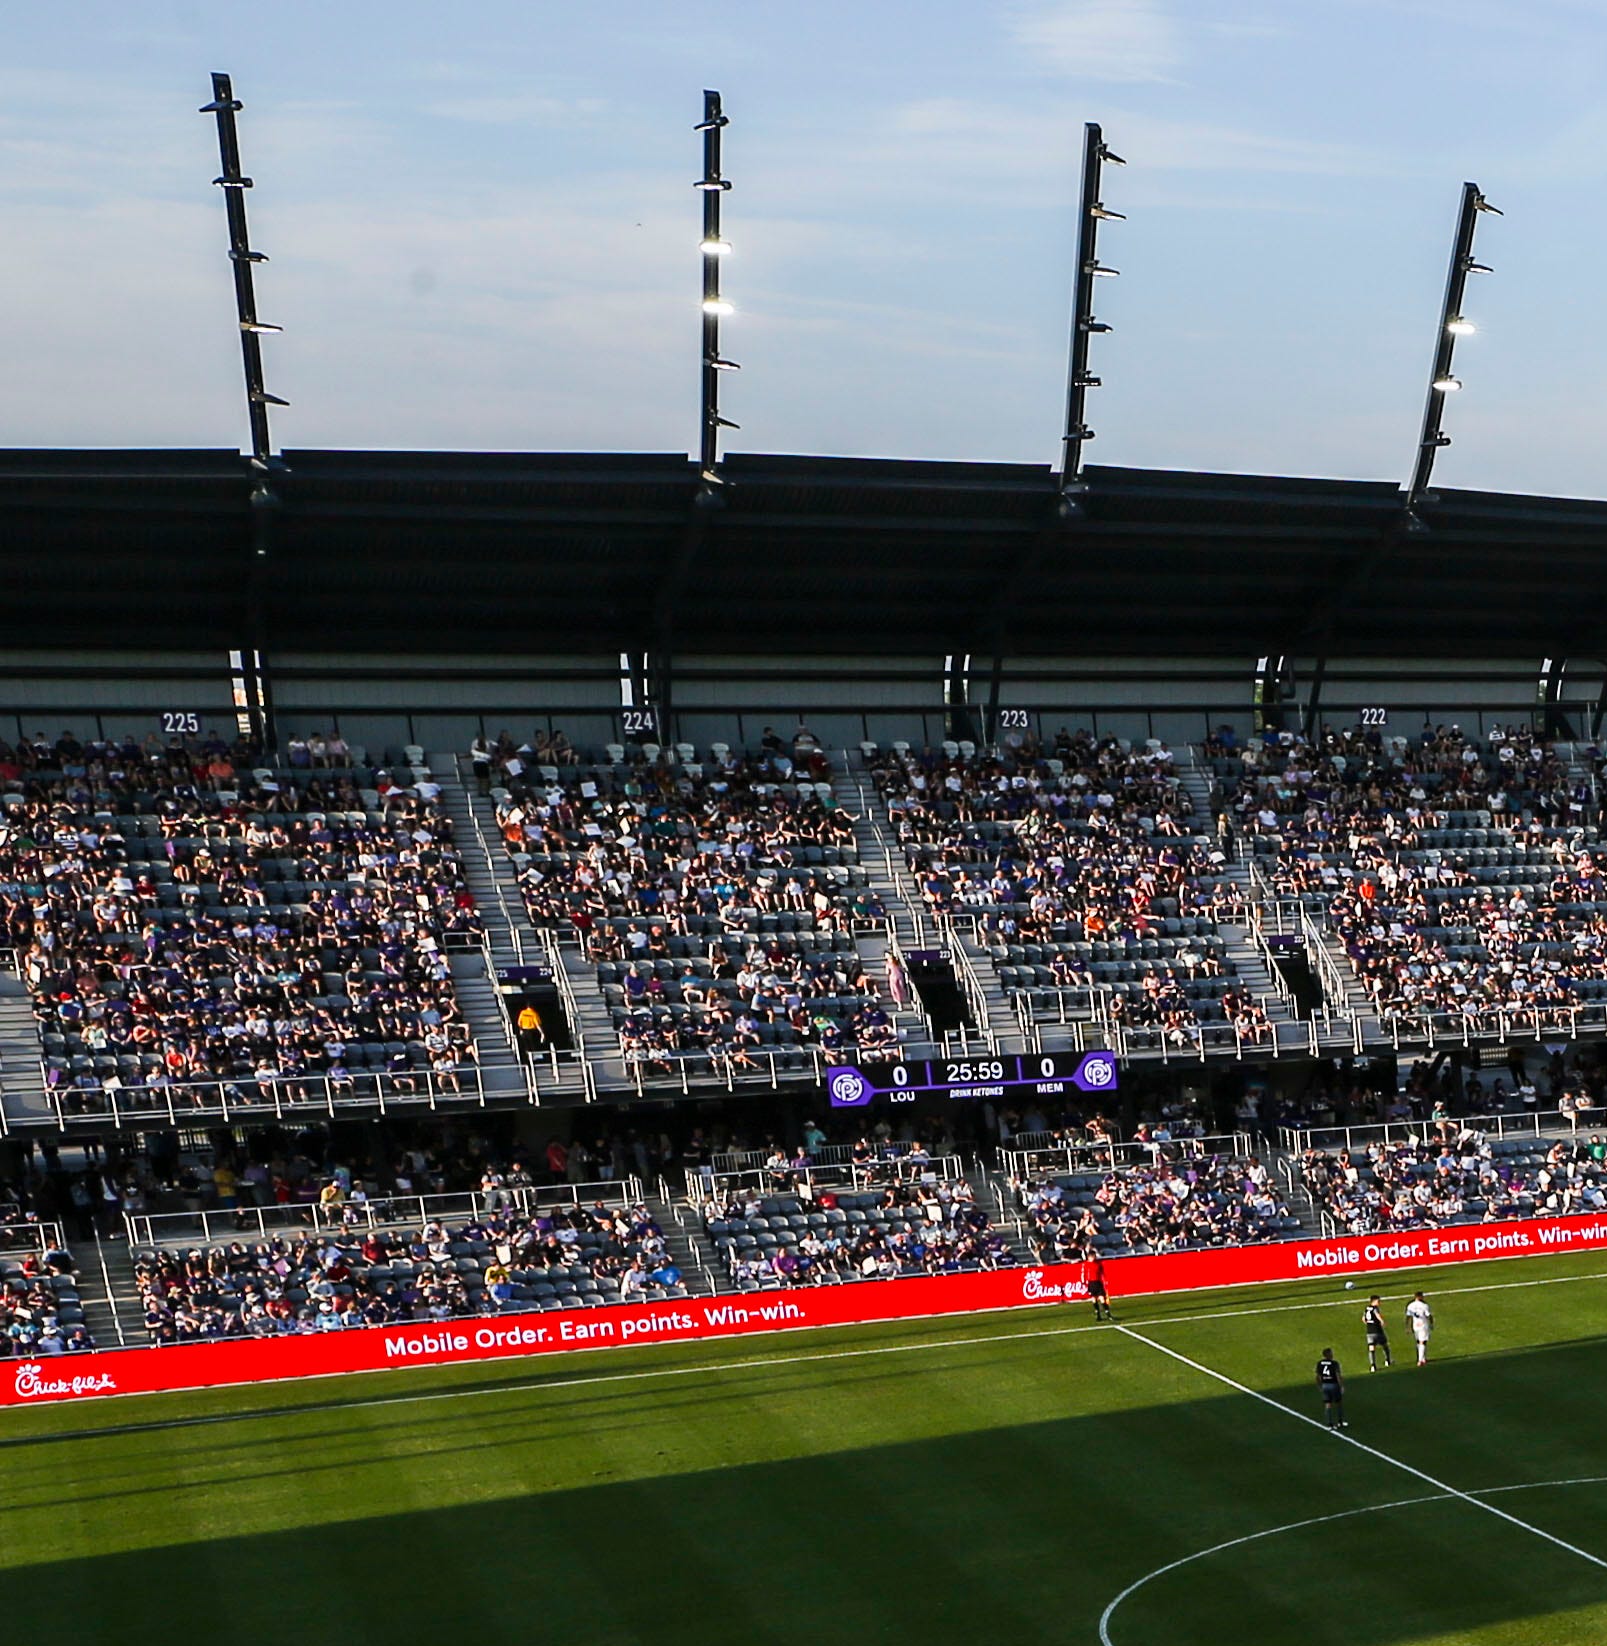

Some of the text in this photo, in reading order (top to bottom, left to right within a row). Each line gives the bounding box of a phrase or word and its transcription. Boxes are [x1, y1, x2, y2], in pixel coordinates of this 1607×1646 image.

[163, 712, 198, 733] 225
[623, 711, 653, 731] 224
[1001, 711, 1028, 728] 223
[1362, 708, 1386, 725] 222
[893, 1066, 907, 1086] 0
[946, 1062, 1004, 1082] 25:59
[1041, 1058, 1055, 1078] 0
[890, 1091, 915, 1103] LOU
[1037, 1082, 1064, 1094] MEM
[1296, 1246, 1358, 1268] Mobile
[1363, 1241, 1422, 1261] Order.
[1428, 1238, 1469, 1255] Earn
[1474, 1232, 1534, 1254] points.
[384, 1301, 806, 1357] Mobile Order. Earn points. Win-win.
[1322, 1365, 1330, 1376] 4
[15, 1367, 117, 1397] Chick-fil-A
